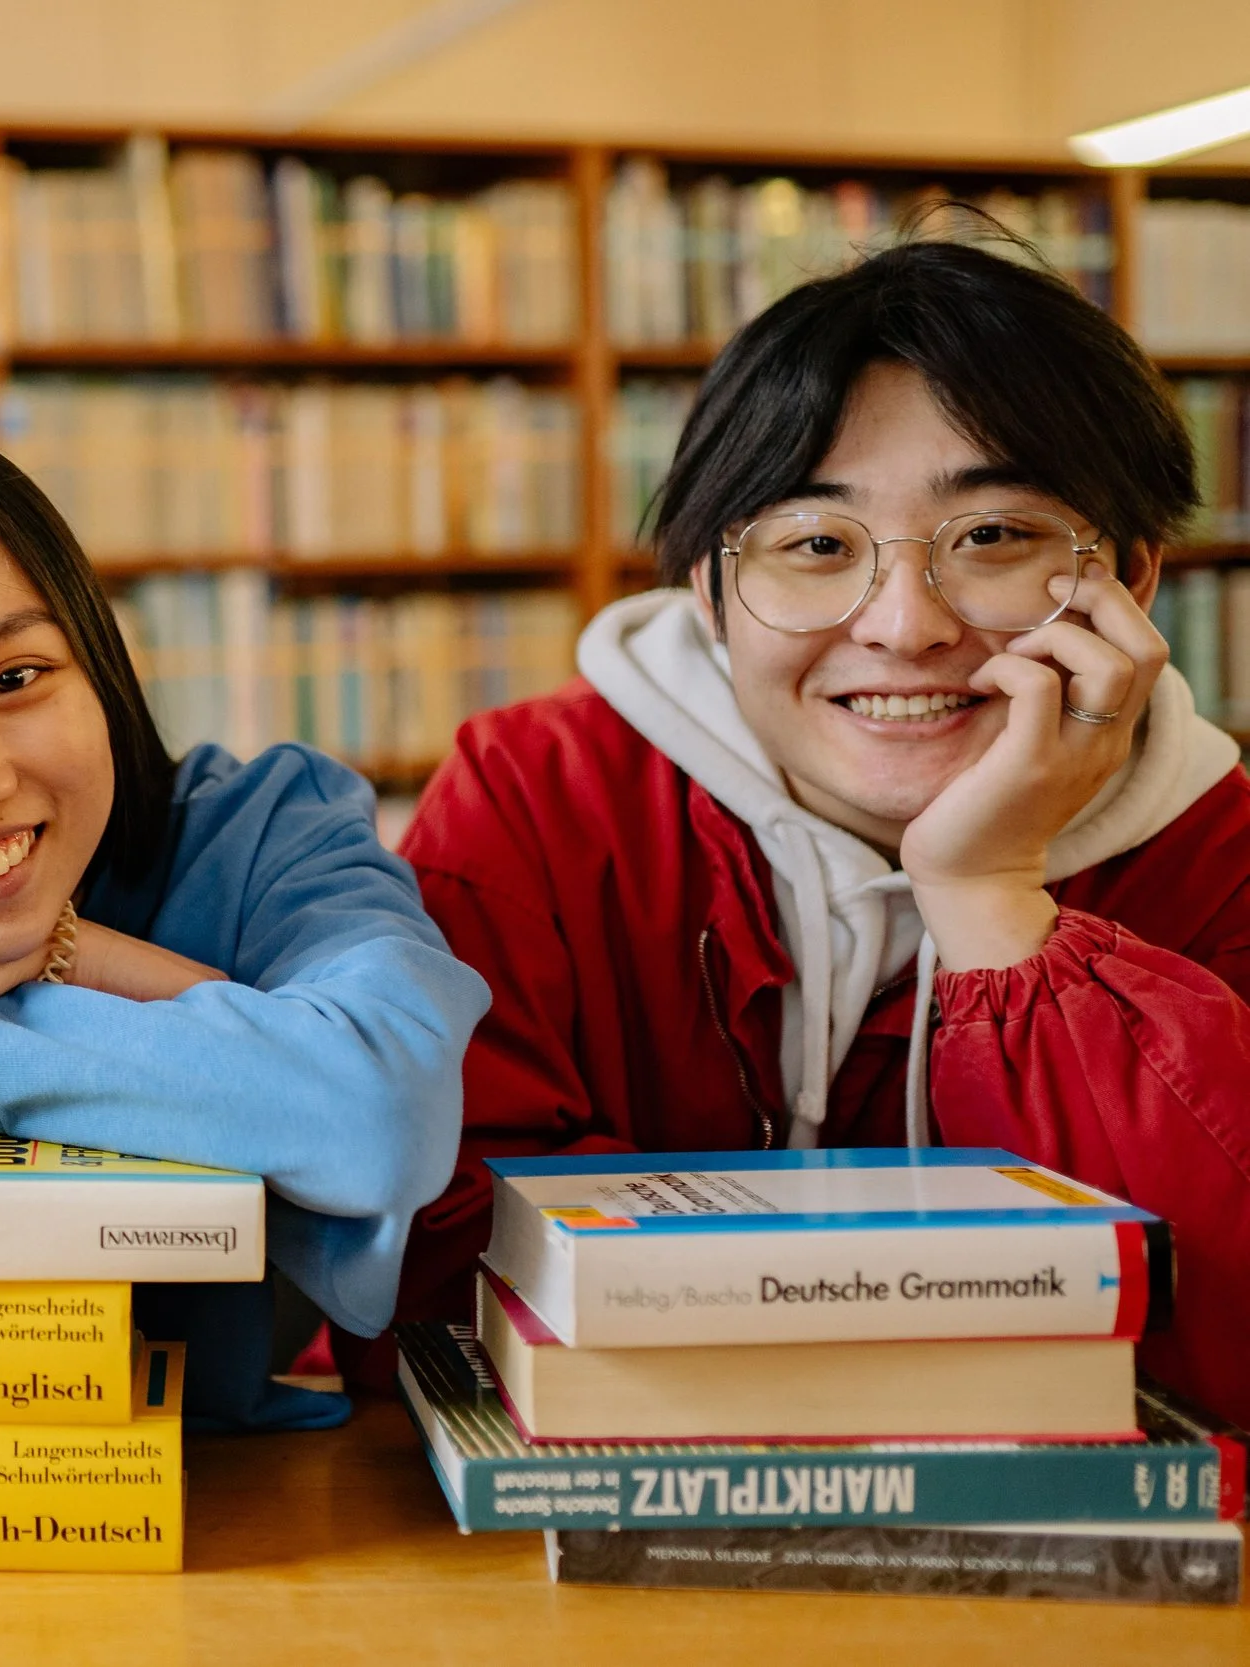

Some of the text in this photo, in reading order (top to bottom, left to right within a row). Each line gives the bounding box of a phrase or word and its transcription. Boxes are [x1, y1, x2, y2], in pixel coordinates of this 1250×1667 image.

[761, 1266, 1067, 1303] Deutsche Grammatik
[12, 1441, 163, 1465] Langenscheidts
[632, 1467, 915, 1516] MARKTPLATZ
[647, 1546, 712, 1561] MEMORIA
[715, 1550, 772, 1563] SILESIAE
[784, 1552, 814, 1564] ZUM
[816, 1553, 884, 1567] GEDENKEN
[887, 1557, 907, 1567] AN
[910, 1556, 960, 1569] MARIAN
